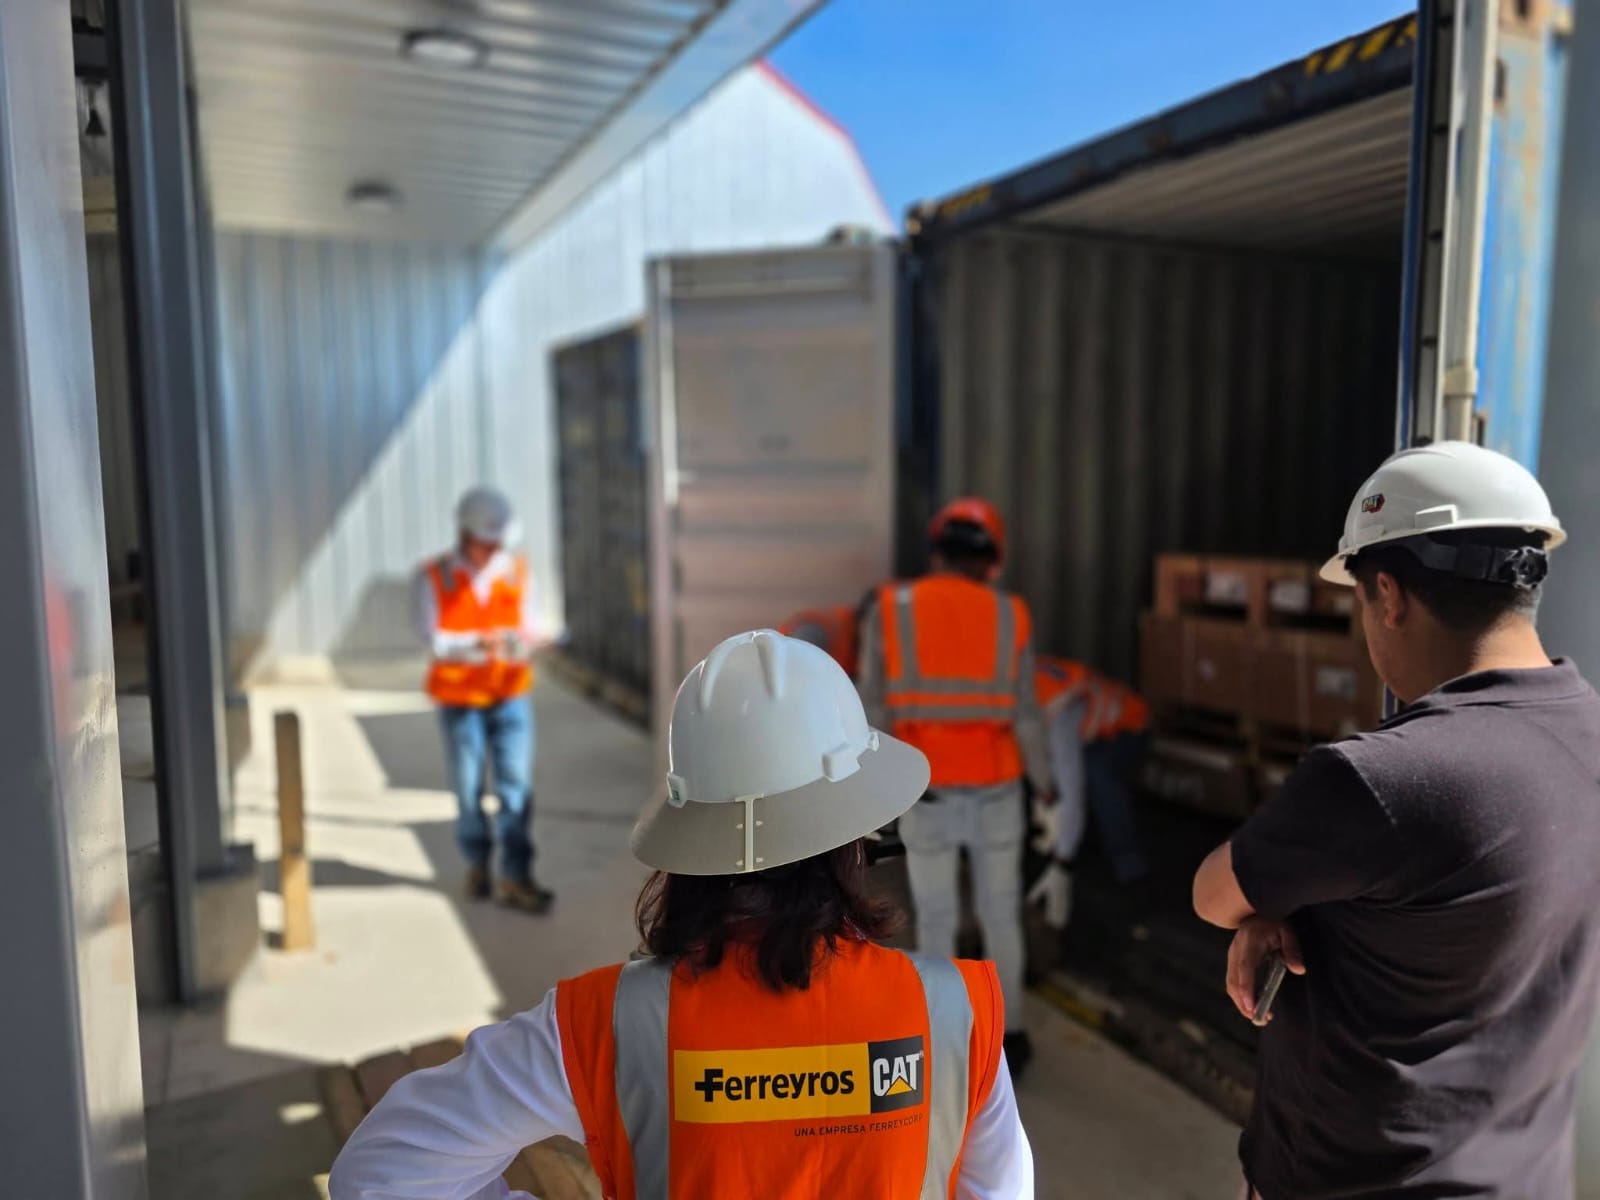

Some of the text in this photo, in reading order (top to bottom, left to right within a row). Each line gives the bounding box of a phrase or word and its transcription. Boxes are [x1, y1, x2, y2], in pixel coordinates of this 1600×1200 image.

[695, 1068, 854, 1102] Ferreyros
[873, 1052, 920, 1097] CAT
[794, 1127, 816, 1137] UNA
[819, 1124, 866, 1136] EMPRESA
